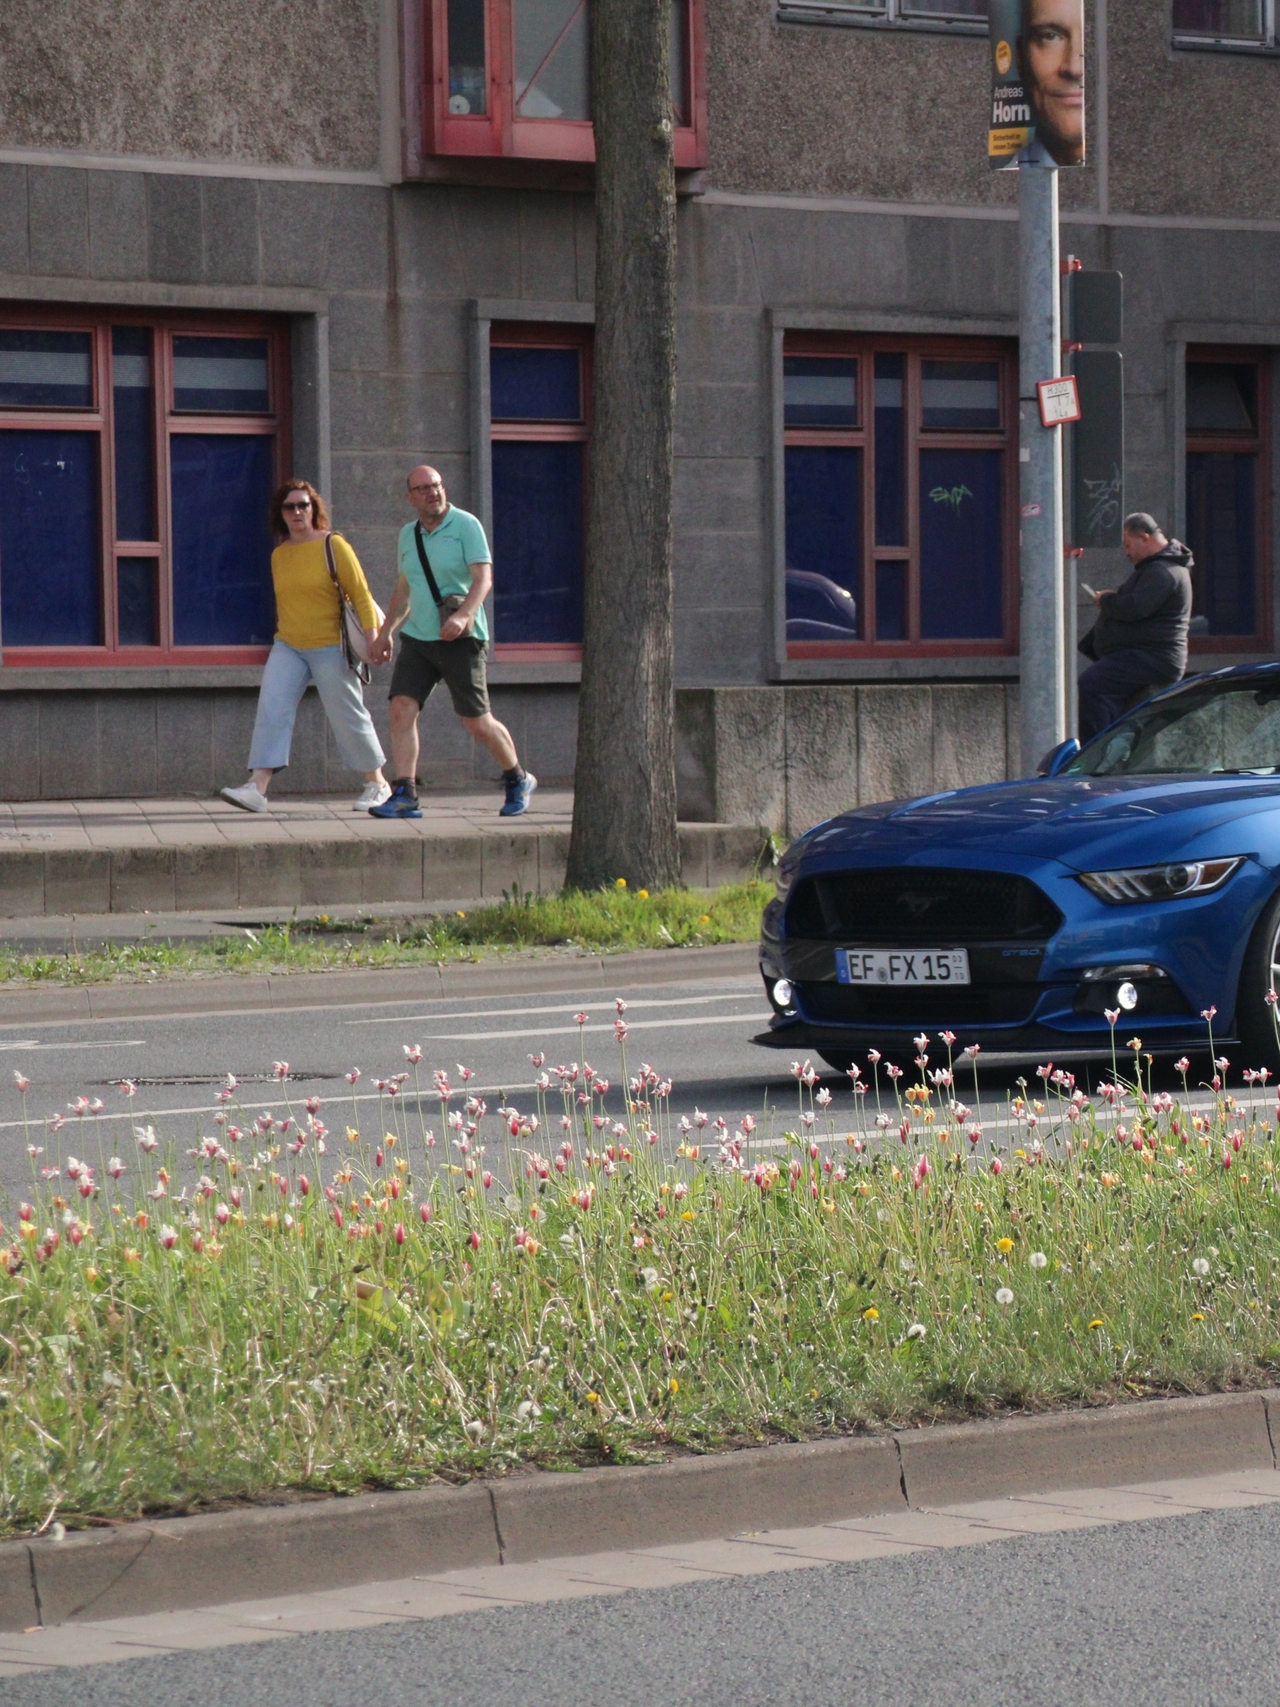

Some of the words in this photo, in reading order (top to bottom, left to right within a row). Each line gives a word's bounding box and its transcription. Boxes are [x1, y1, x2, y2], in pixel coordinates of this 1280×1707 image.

[994, 86, 1023, 98] Andreas
[993, 101, 1030, 123] Horn
[848, 954, 874, 980] EF
[889, 954, 918, 981] FX
[923, 955, 950, 981] 15
